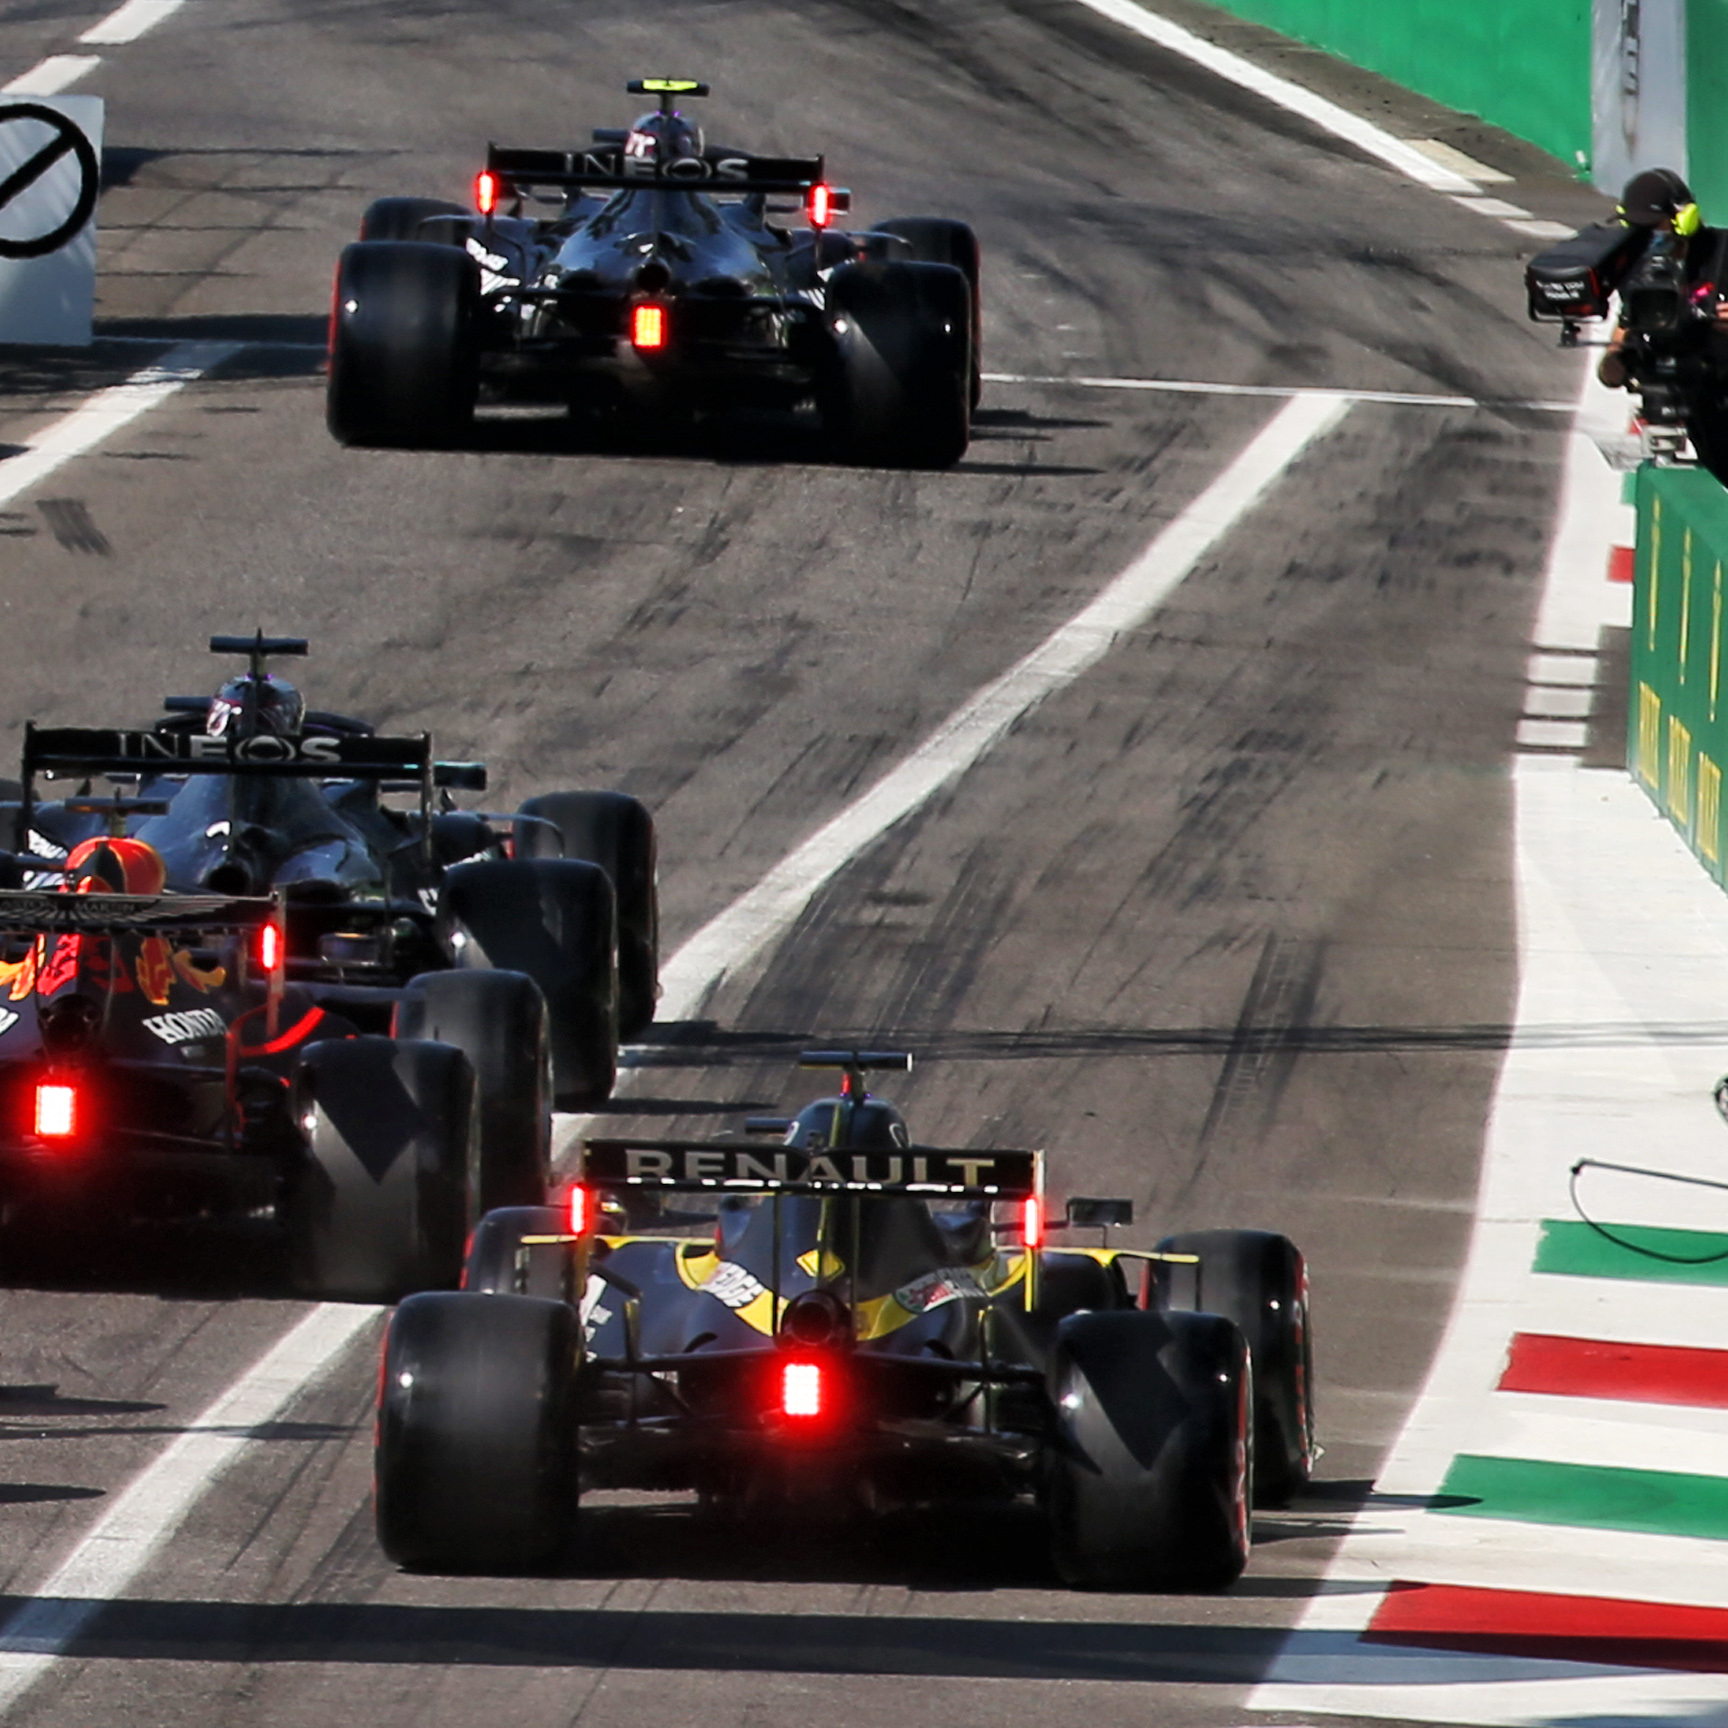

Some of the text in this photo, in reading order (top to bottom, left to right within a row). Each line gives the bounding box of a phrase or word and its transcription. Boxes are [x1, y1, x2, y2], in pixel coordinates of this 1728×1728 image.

[563, 153, 749, 181] INEOS
[117, 733, 342, 763] INEOS
[142, 1007, 228, 1045] HONDA
[626, 1147, 997, 1189] RENAULT
